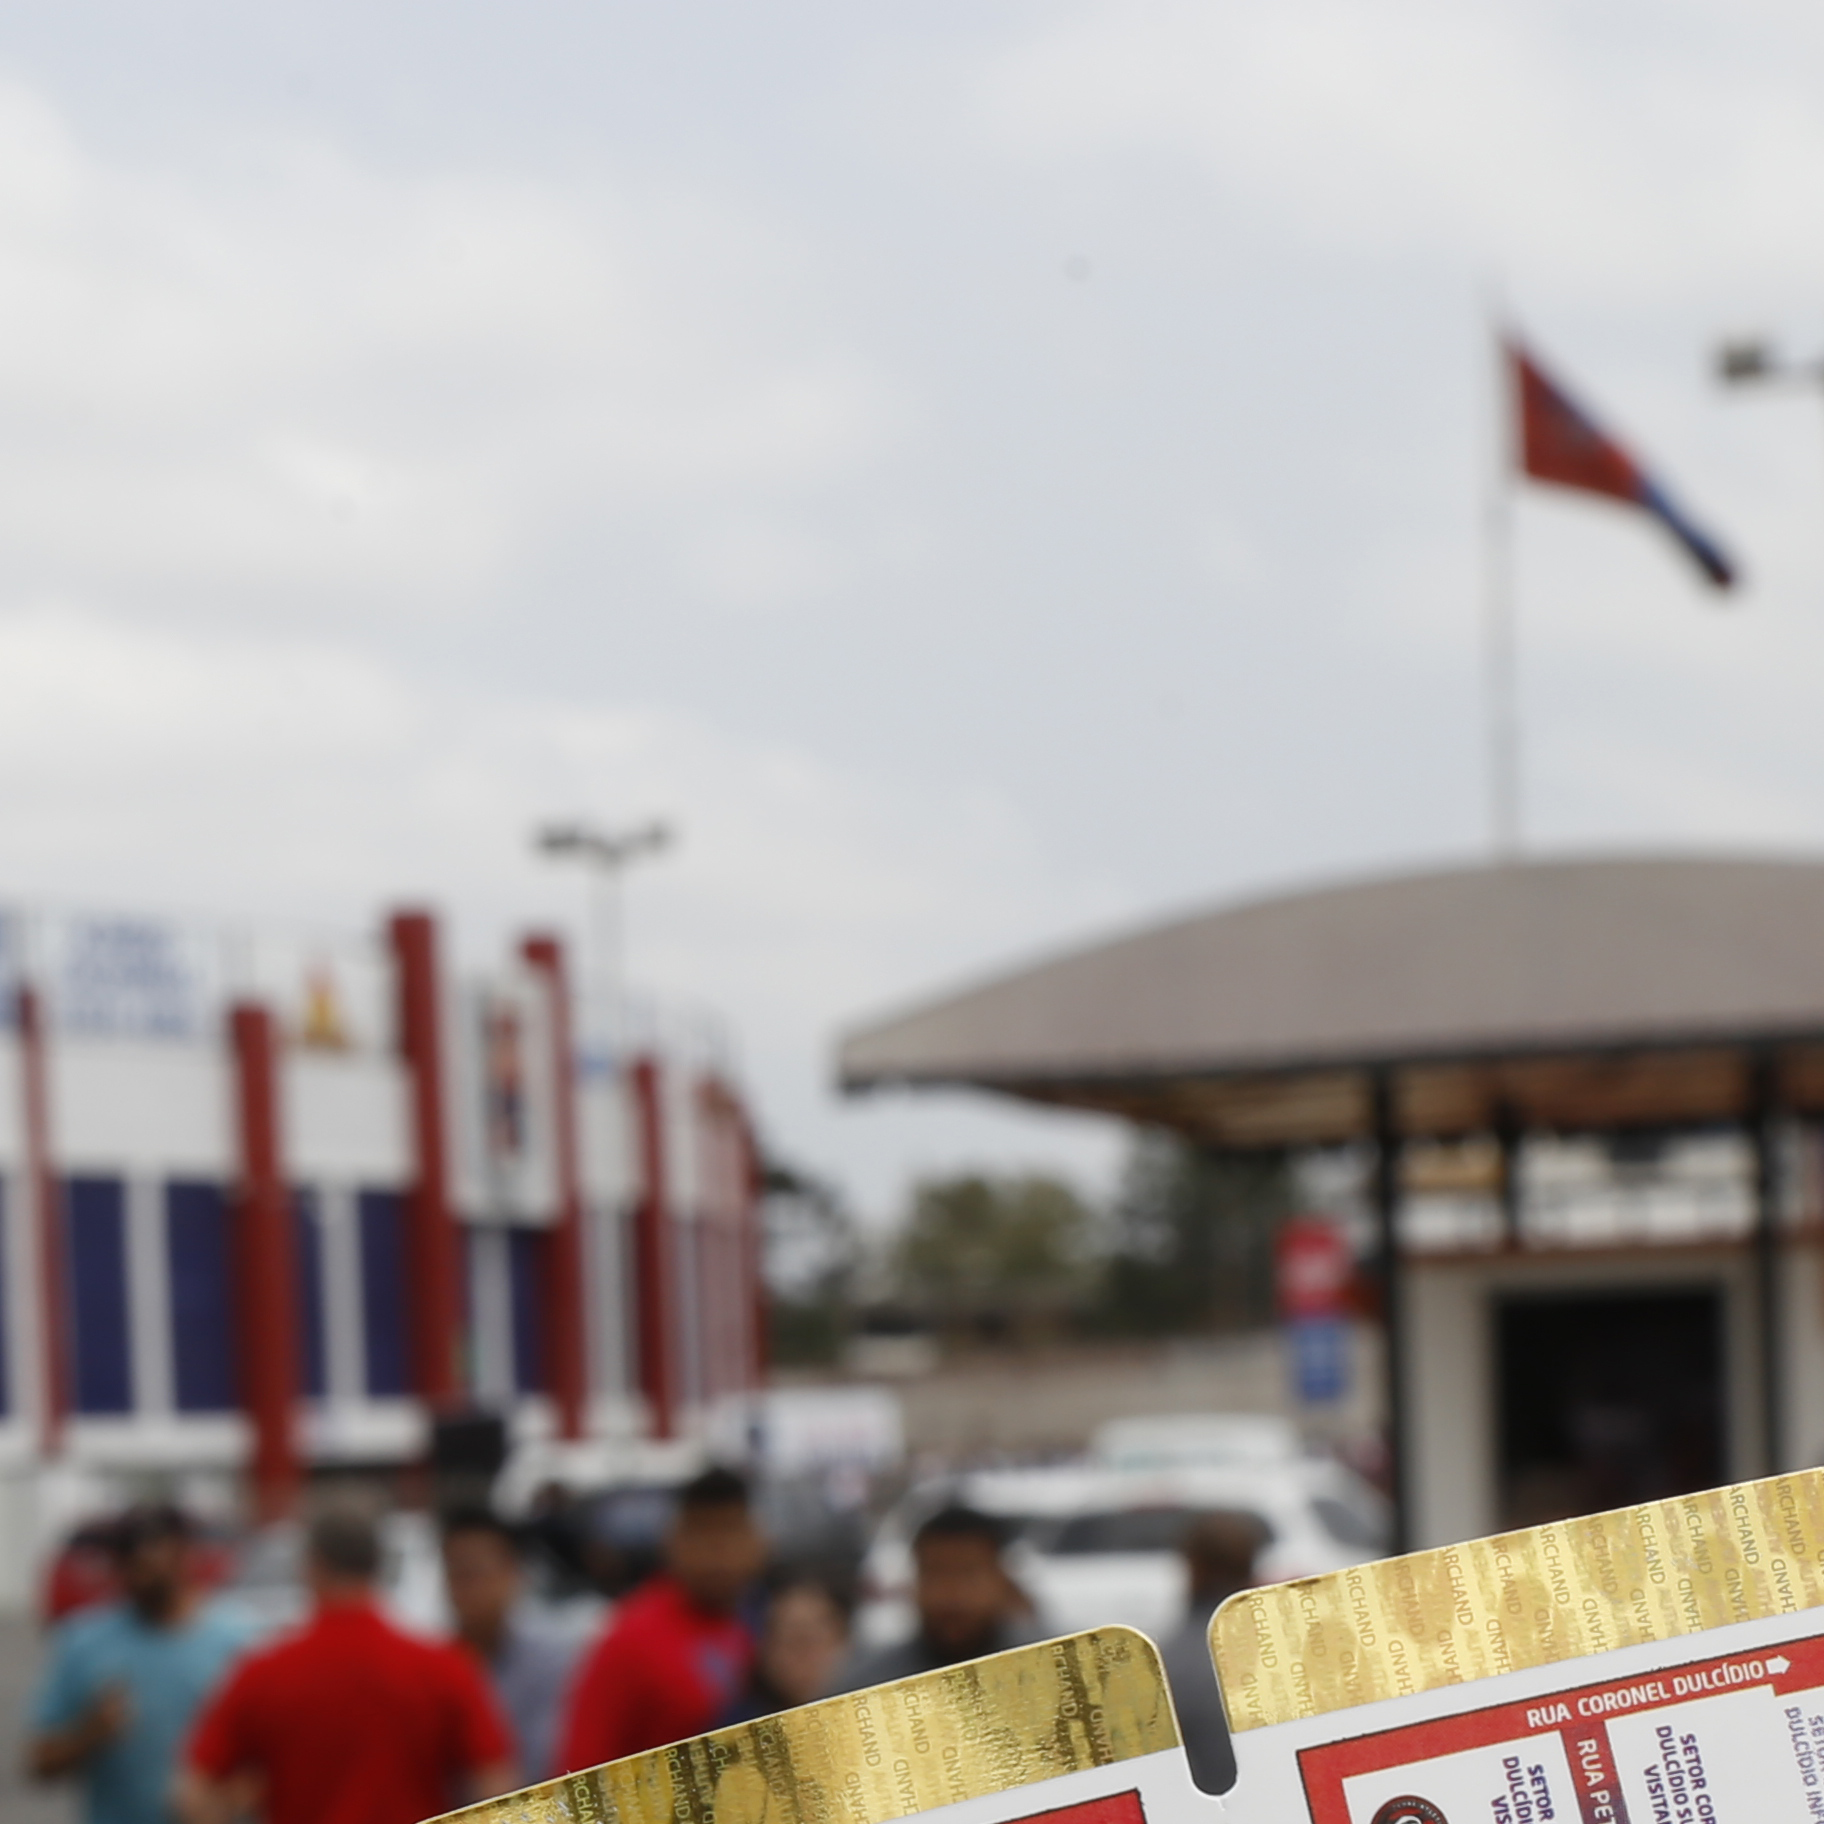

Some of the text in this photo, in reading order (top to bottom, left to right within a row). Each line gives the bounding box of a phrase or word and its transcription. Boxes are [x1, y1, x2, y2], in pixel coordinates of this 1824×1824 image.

[1525, 1655, 1765, 1728] RUA CORONEL DULCÍDIO
[1575, 1737, 1607, 1788] RUA
[1526, 1763, 1555, 1823] SETOR
